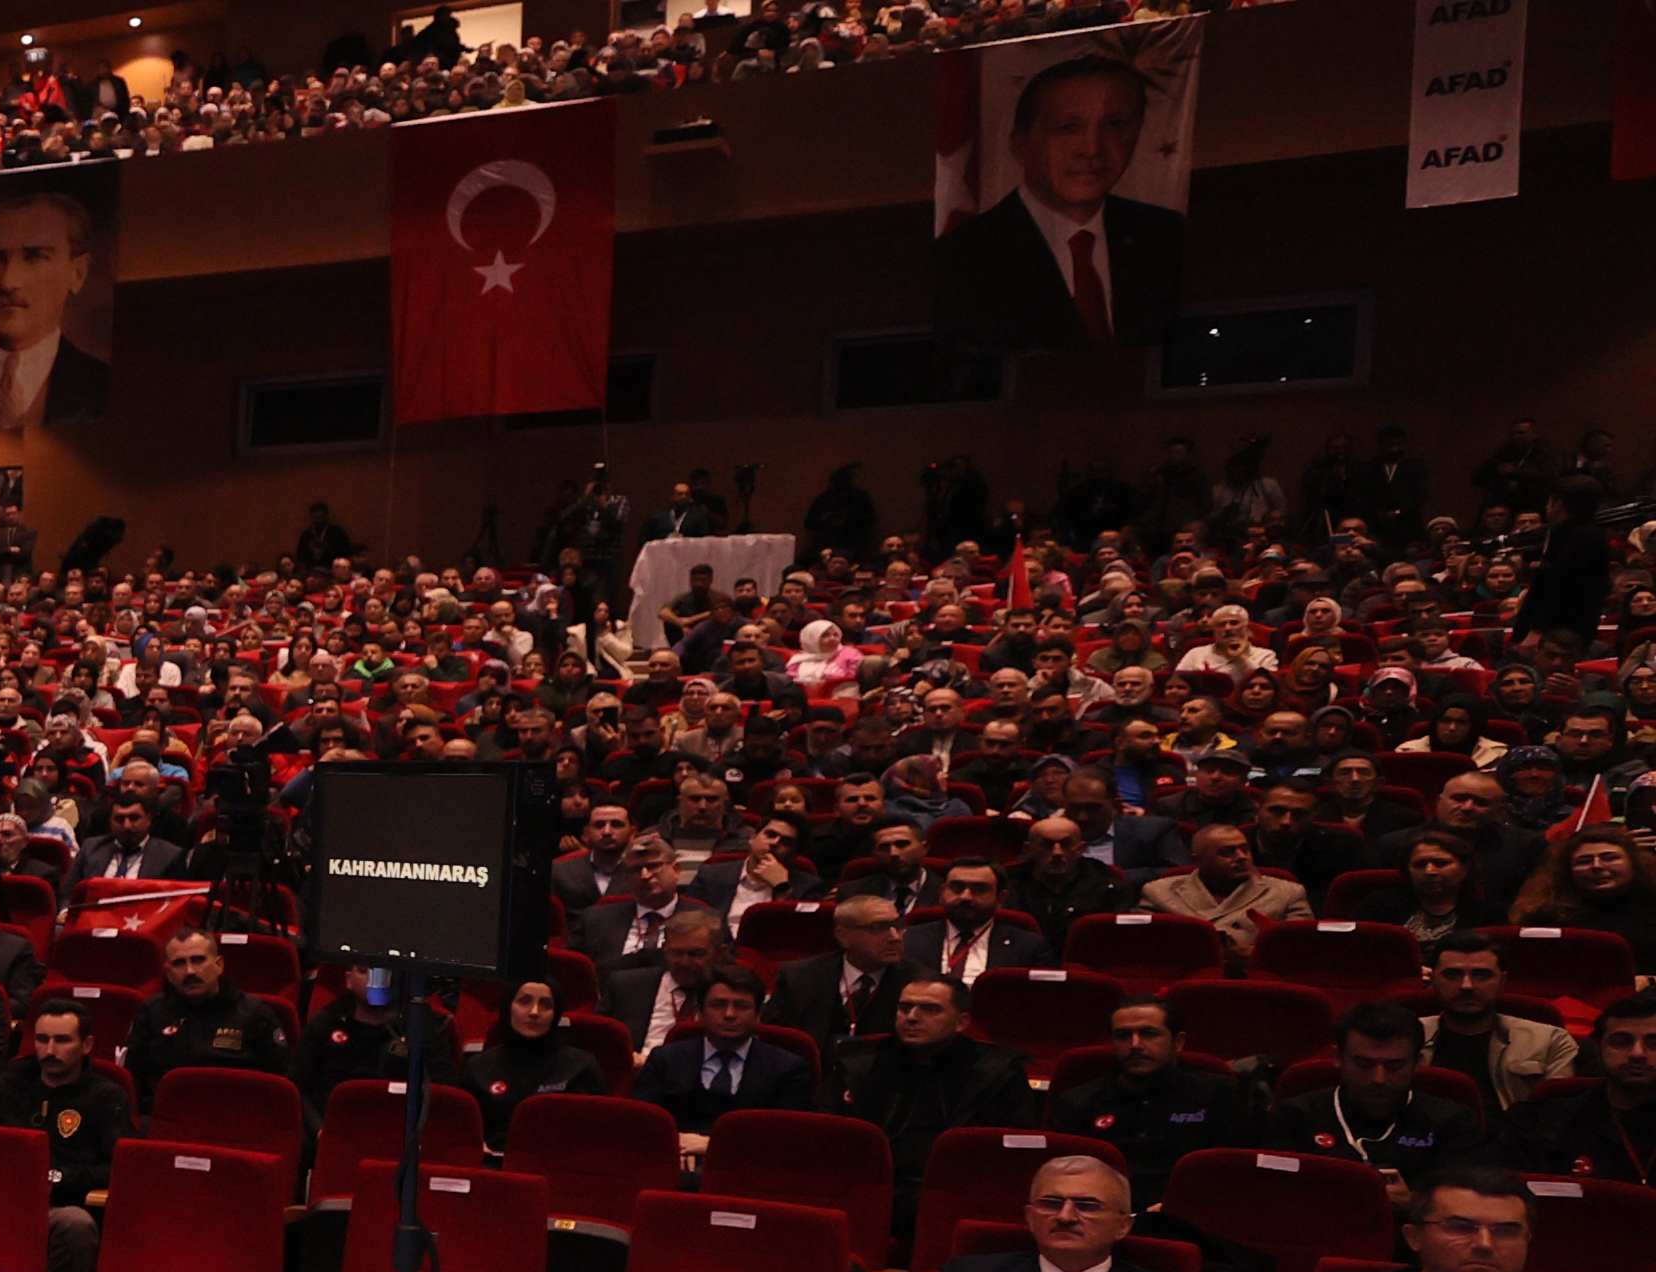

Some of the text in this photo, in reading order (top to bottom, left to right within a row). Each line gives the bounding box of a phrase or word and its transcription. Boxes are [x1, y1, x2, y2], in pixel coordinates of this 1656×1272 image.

[1429, 0, 1511, 26] AFAD
[1425, 68, 1508, 97] AFAD
[1421, 142, 1504, 170] AFAD
[329, 858, 489, 888] KAHRAMANMARAŞ
